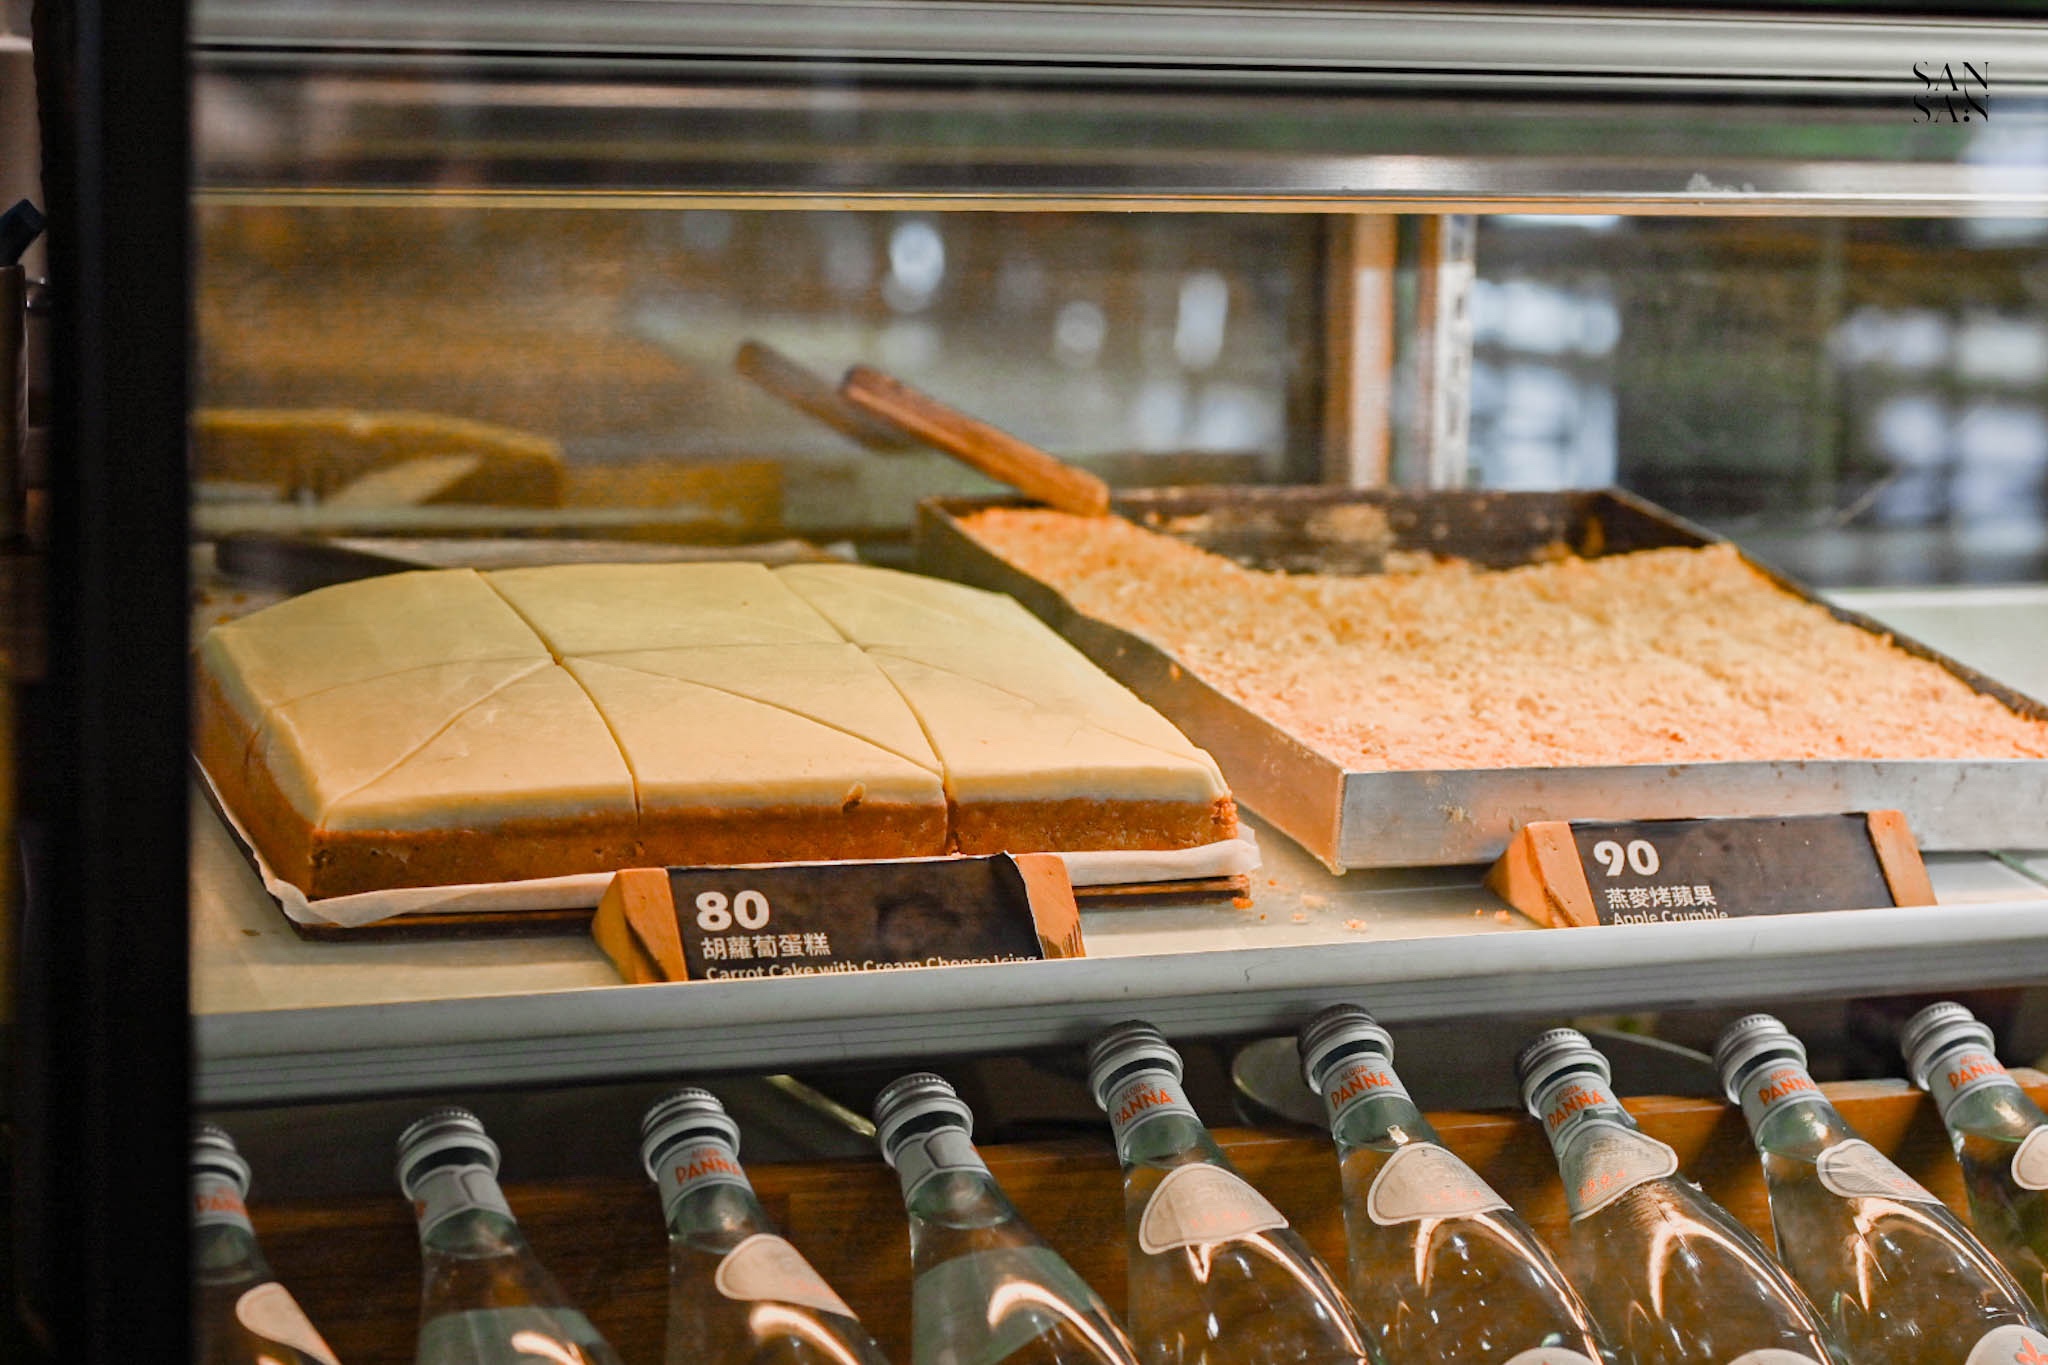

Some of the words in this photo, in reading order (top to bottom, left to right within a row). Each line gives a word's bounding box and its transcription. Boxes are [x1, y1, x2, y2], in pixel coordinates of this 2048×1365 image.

[1593, 840, 1661, 877] 90
[695, 890, 770, 932] 80
[1604, 885, 1718, 910] 燕麥烤蘋果
[1614, 911, 1658, 926] Apple
[1661, 908, 1728, 923] Crumble
[701, 932, 832, 961] 胡蘿蔔蛋糕
[706, 966, 764, 981] Carrot
[769, 963, 814, 978] Cake
[818, 960, 859, 975] with
[863, 960, 921, 972] Cream
[1114, 1087, 1175, 1126] PANNA
[1331, 1071, 1393, 1111] PANNA
[1758, 1077, 1817, 1108] PANNA
[1547, 1089, 1608, 1132] PANNA
[675, 1158, 741, 1185] PANNA
